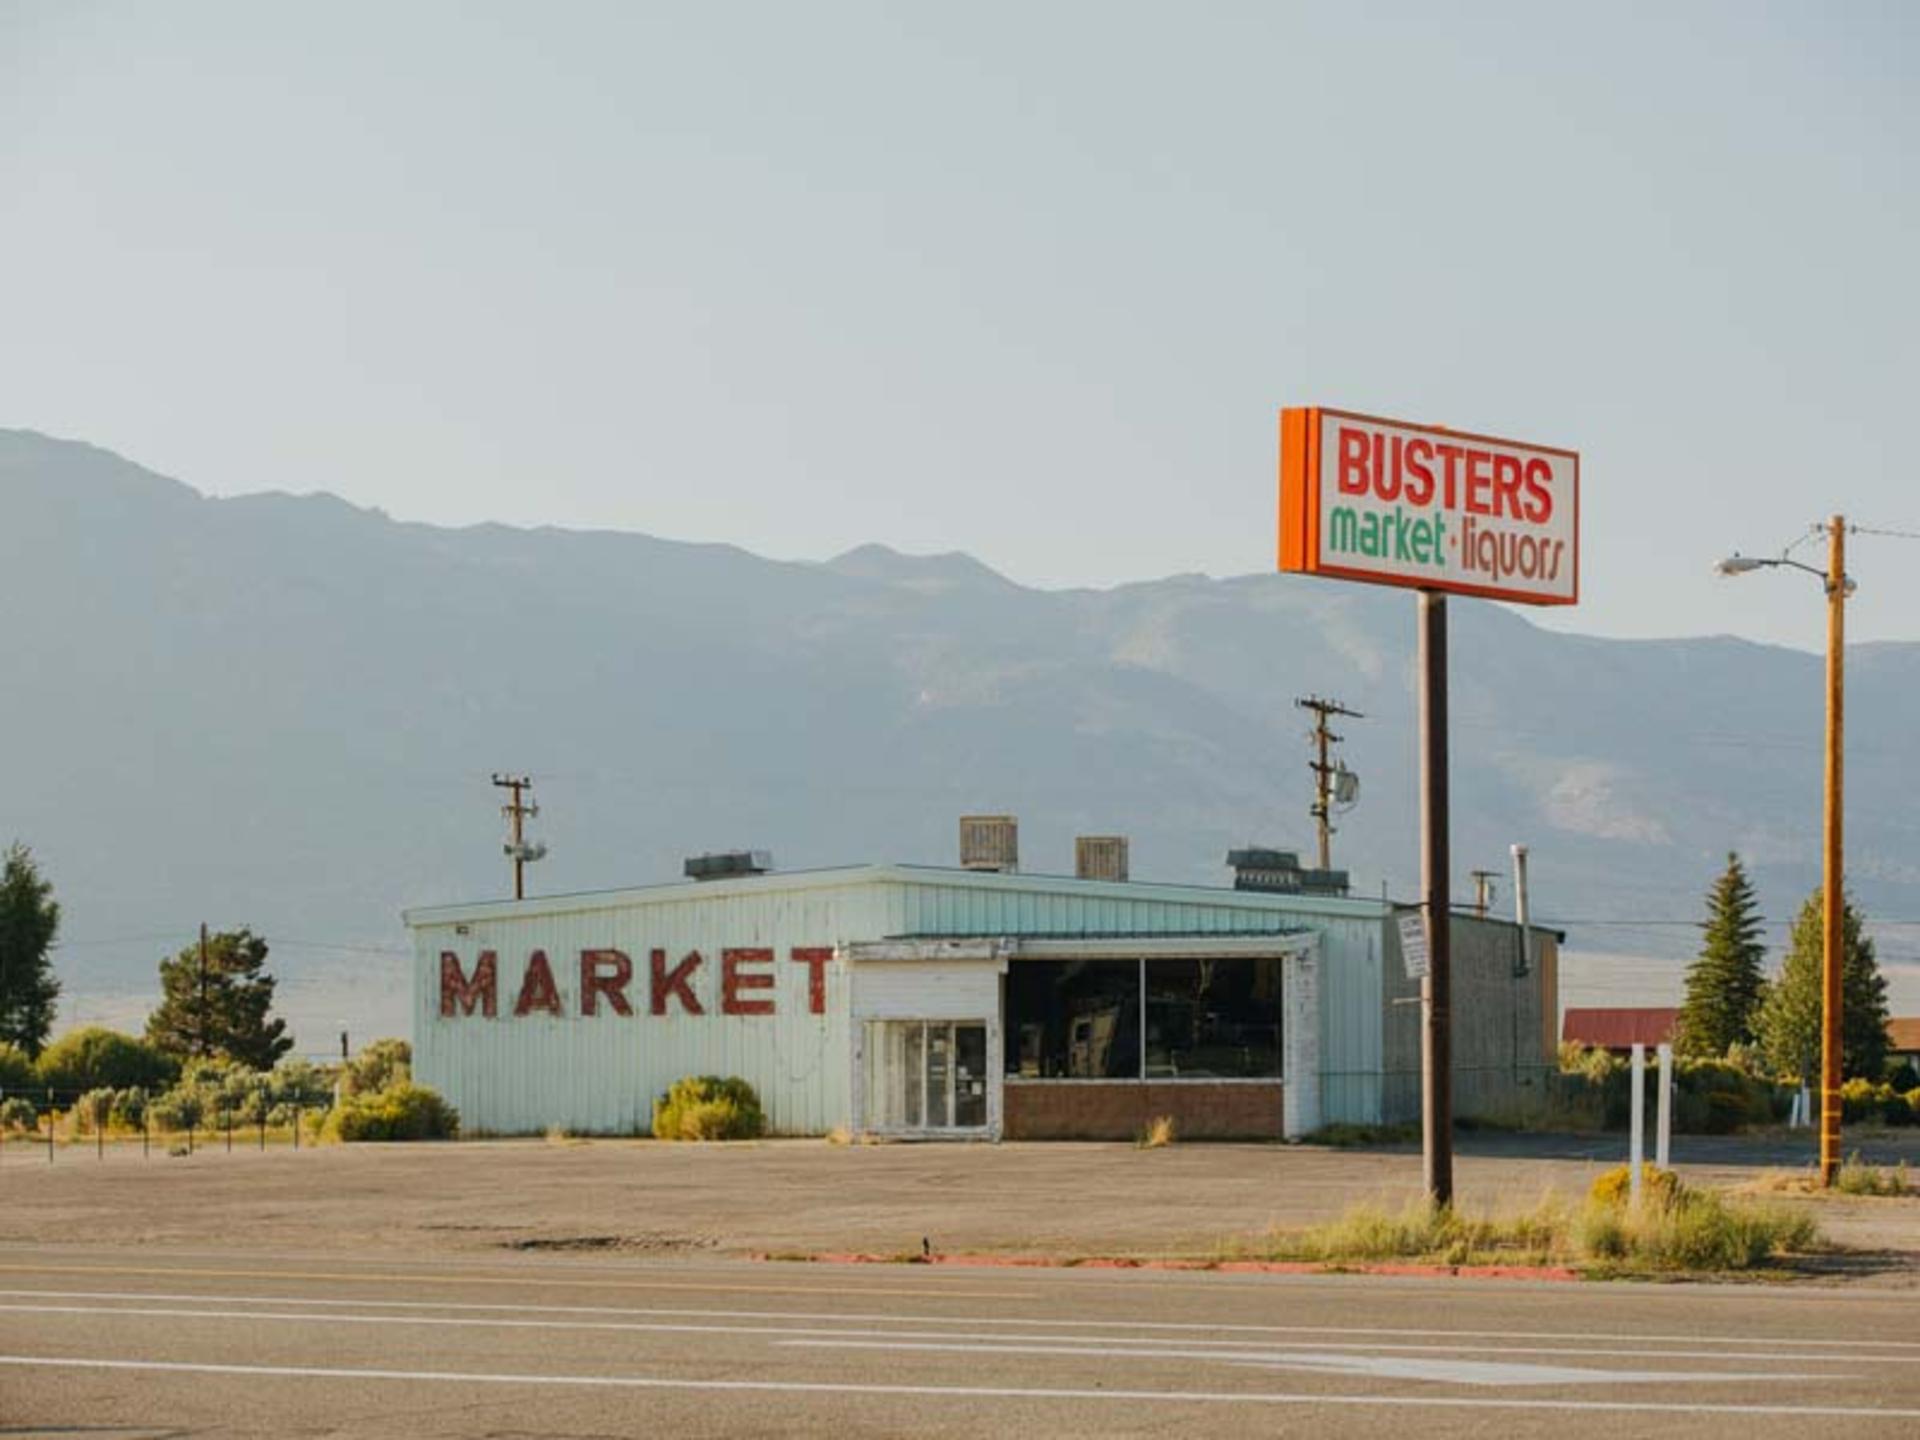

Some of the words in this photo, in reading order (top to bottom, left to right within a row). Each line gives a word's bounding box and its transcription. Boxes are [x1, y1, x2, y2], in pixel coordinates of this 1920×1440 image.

[1338, 427, 1553, 524] BUSTERS
[1329, 505, 1446, 566] market
[1461, 515, 1564, 582] liquors
[440, 946, 836, 1018] MARKET
